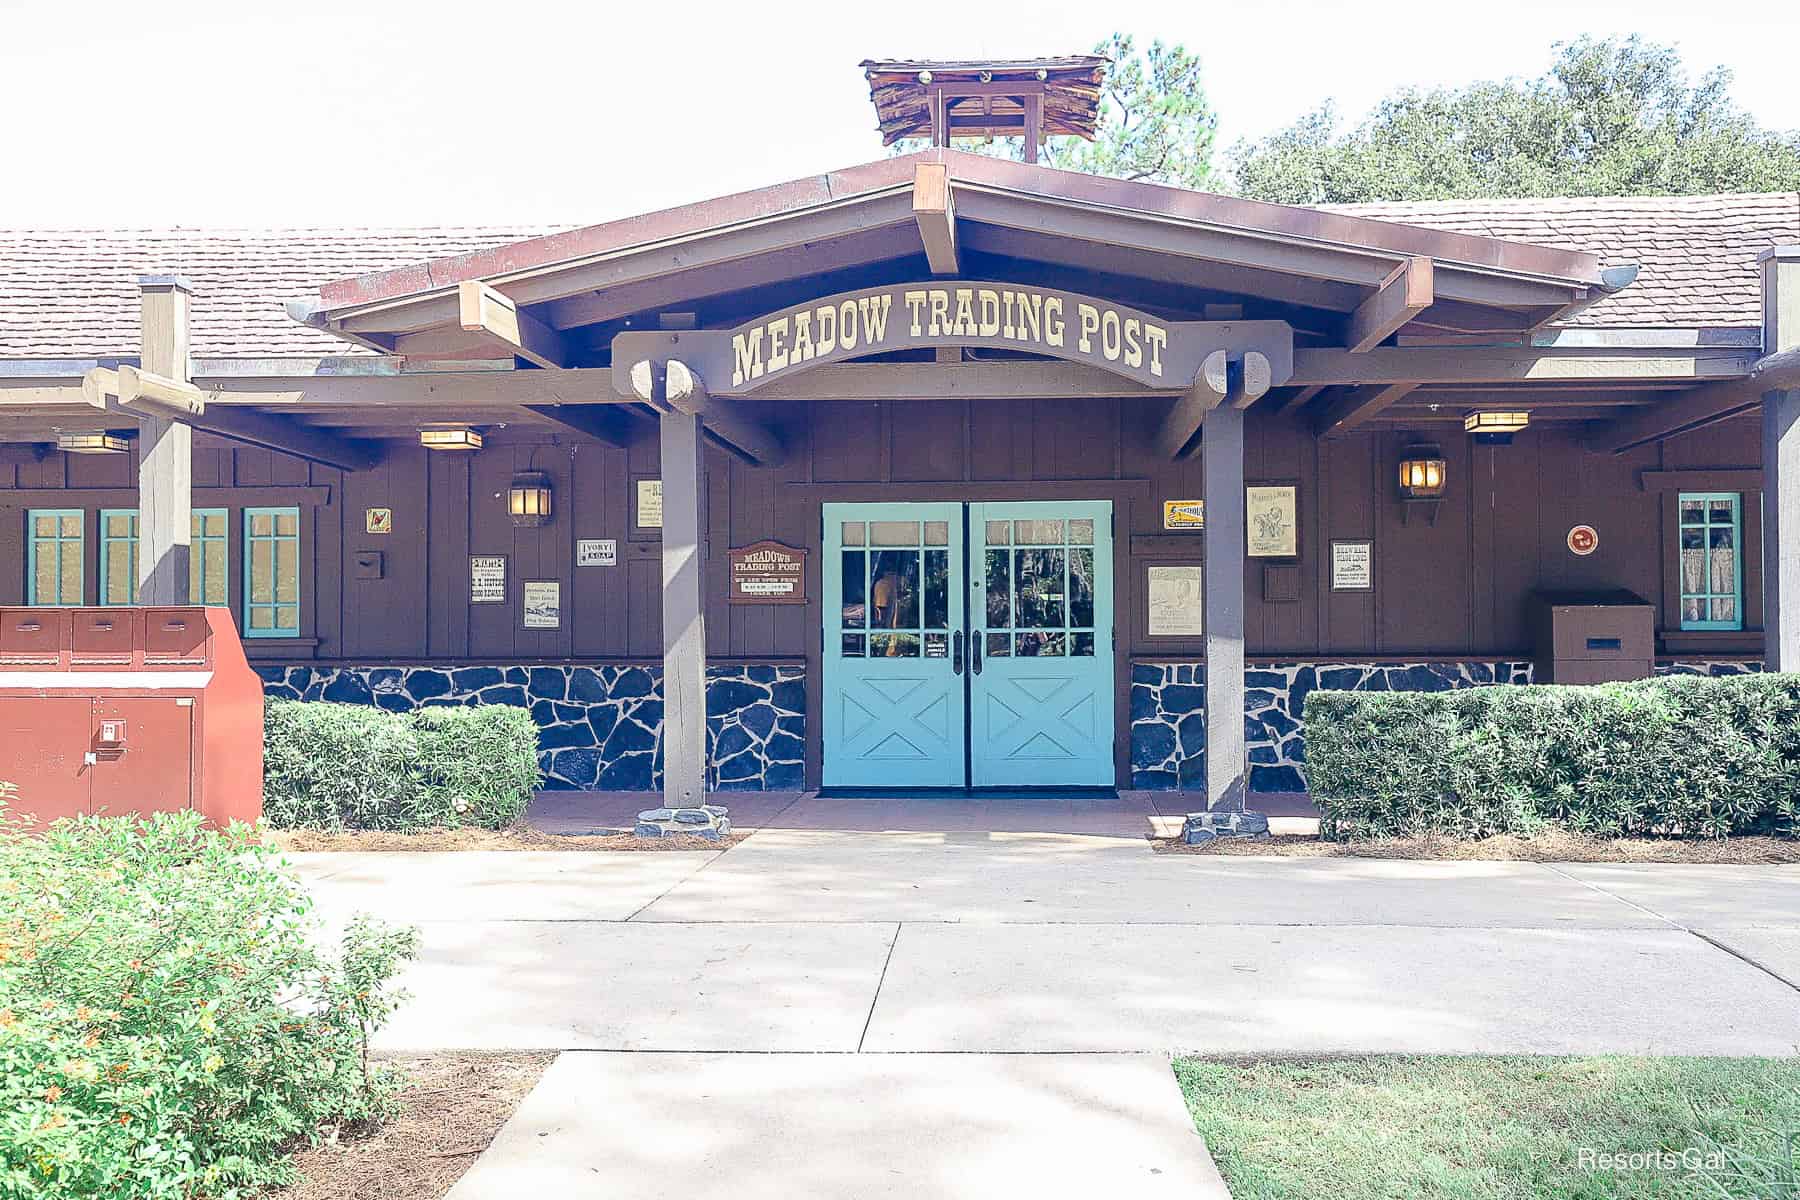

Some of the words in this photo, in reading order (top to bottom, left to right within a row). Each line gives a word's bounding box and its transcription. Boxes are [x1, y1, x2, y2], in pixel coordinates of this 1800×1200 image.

[732, 294, 892, 387] MEADOW
[905, 288, 1066, 348] TRADING
[1078, 303, 1168, 377] POST
[735, 563, 775, 571] TRADING
[779, 563, 801, 571] POST
